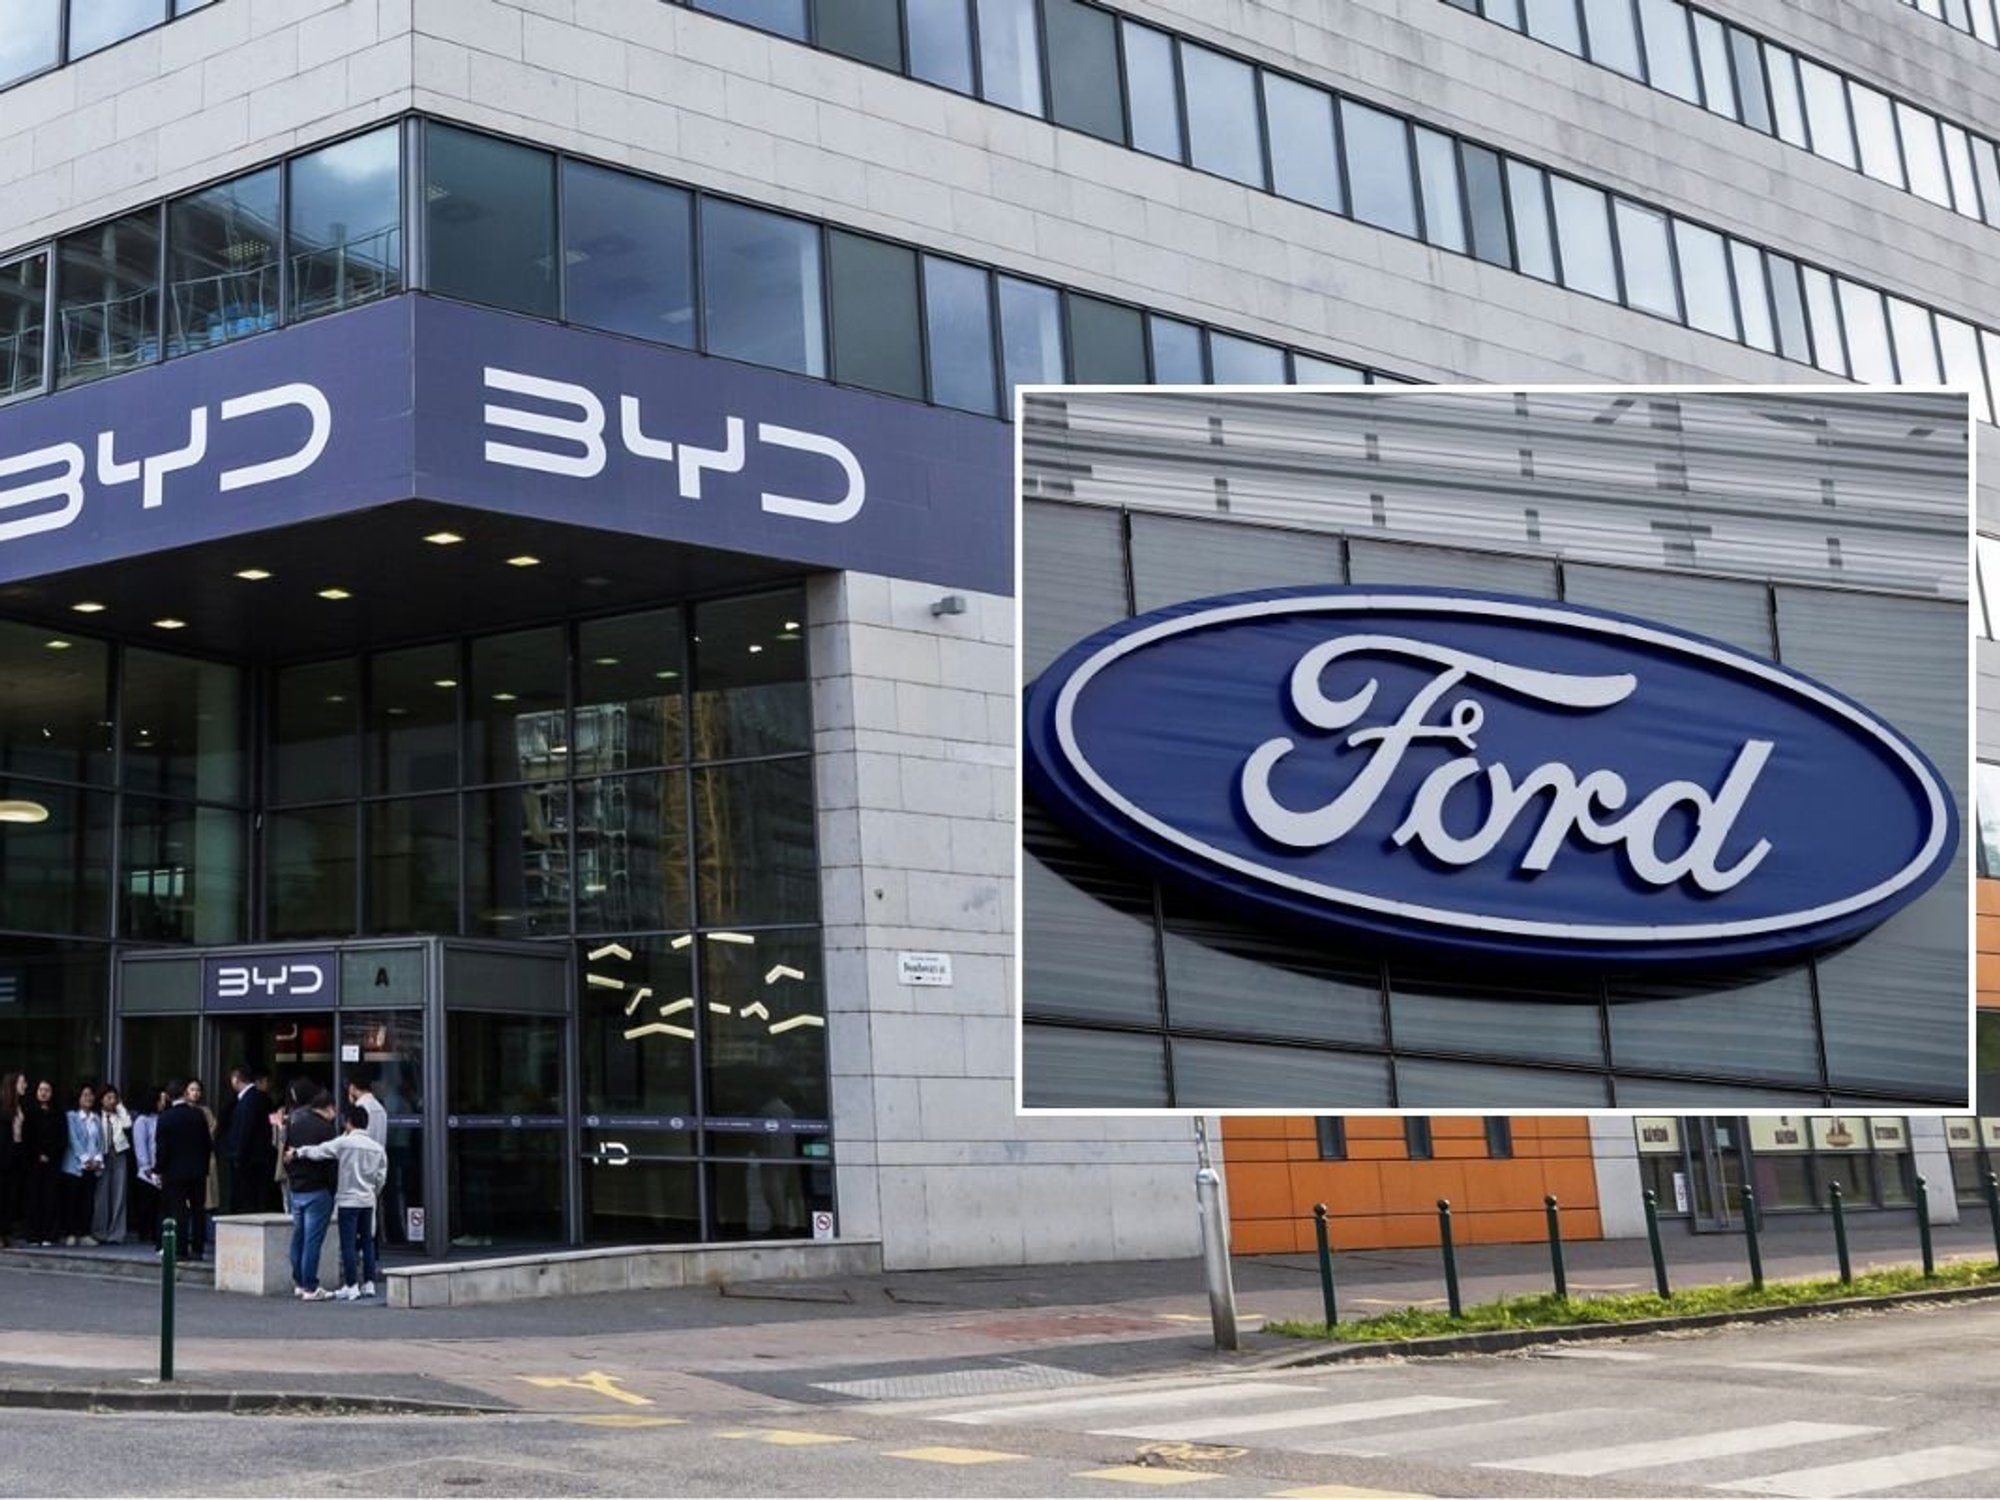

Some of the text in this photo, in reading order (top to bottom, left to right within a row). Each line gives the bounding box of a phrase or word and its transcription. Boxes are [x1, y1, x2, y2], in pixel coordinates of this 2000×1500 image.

[484, 368, 866, 522] BYD
[1242, 635, 1774, 892] Ford
[218, 965, 323, 997] BYD
[375, 967, 390, 987] A
